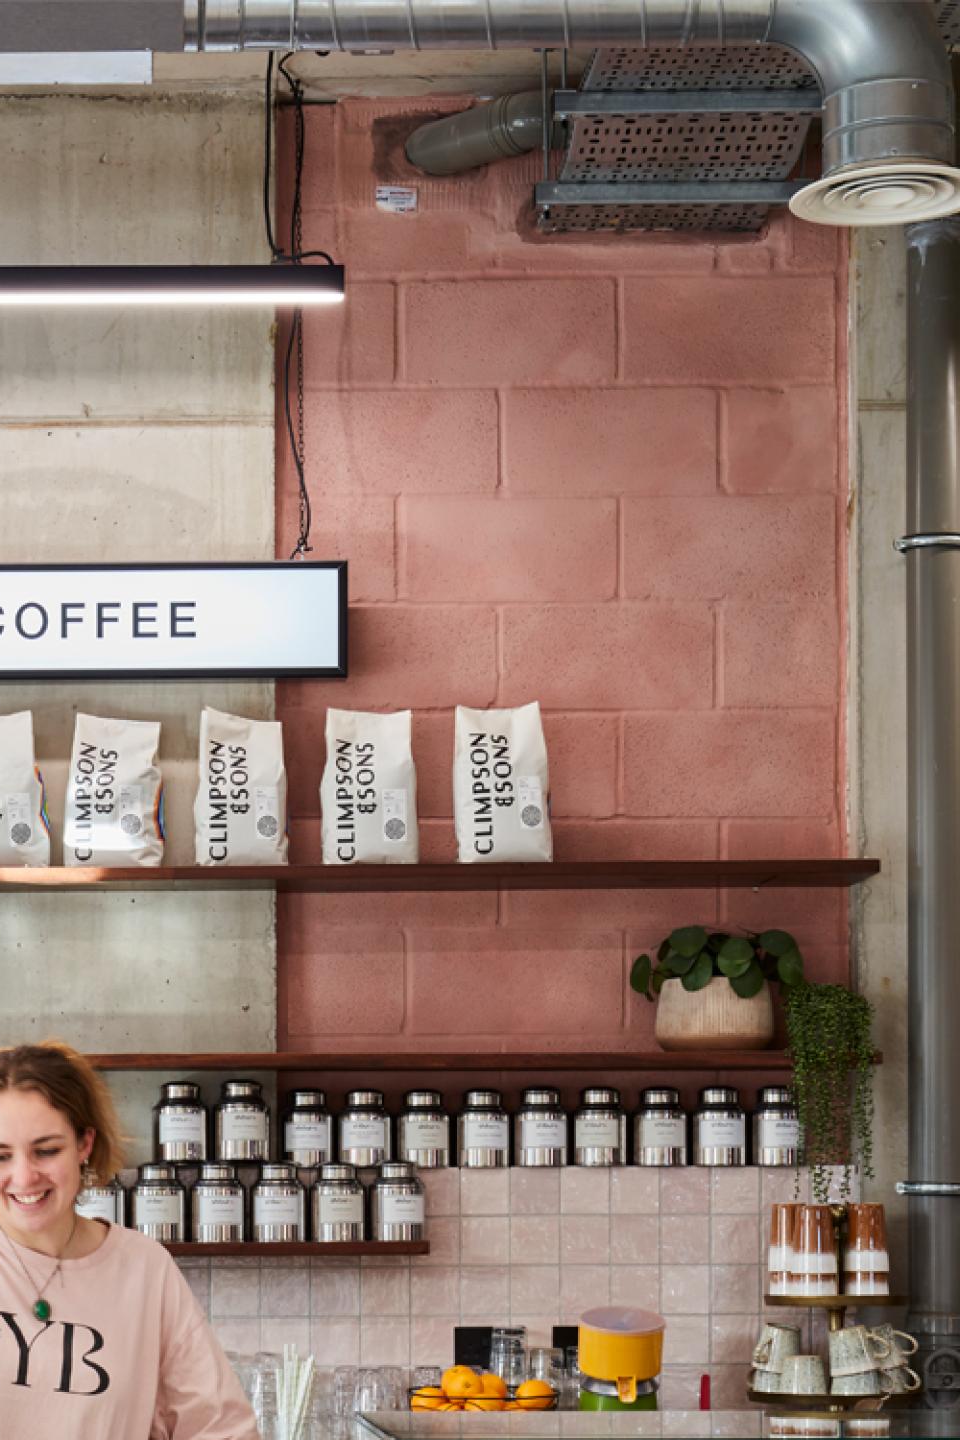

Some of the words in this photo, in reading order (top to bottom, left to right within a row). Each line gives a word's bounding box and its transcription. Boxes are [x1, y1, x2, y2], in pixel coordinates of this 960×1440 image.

[74, 742, 97, 861] CLIMPSON
[208, 740, 228, 861] CLIMPSON
[335, 738, 356, 862] CLIMPSON
[468, 732, 495, 855] CLIMPSON
